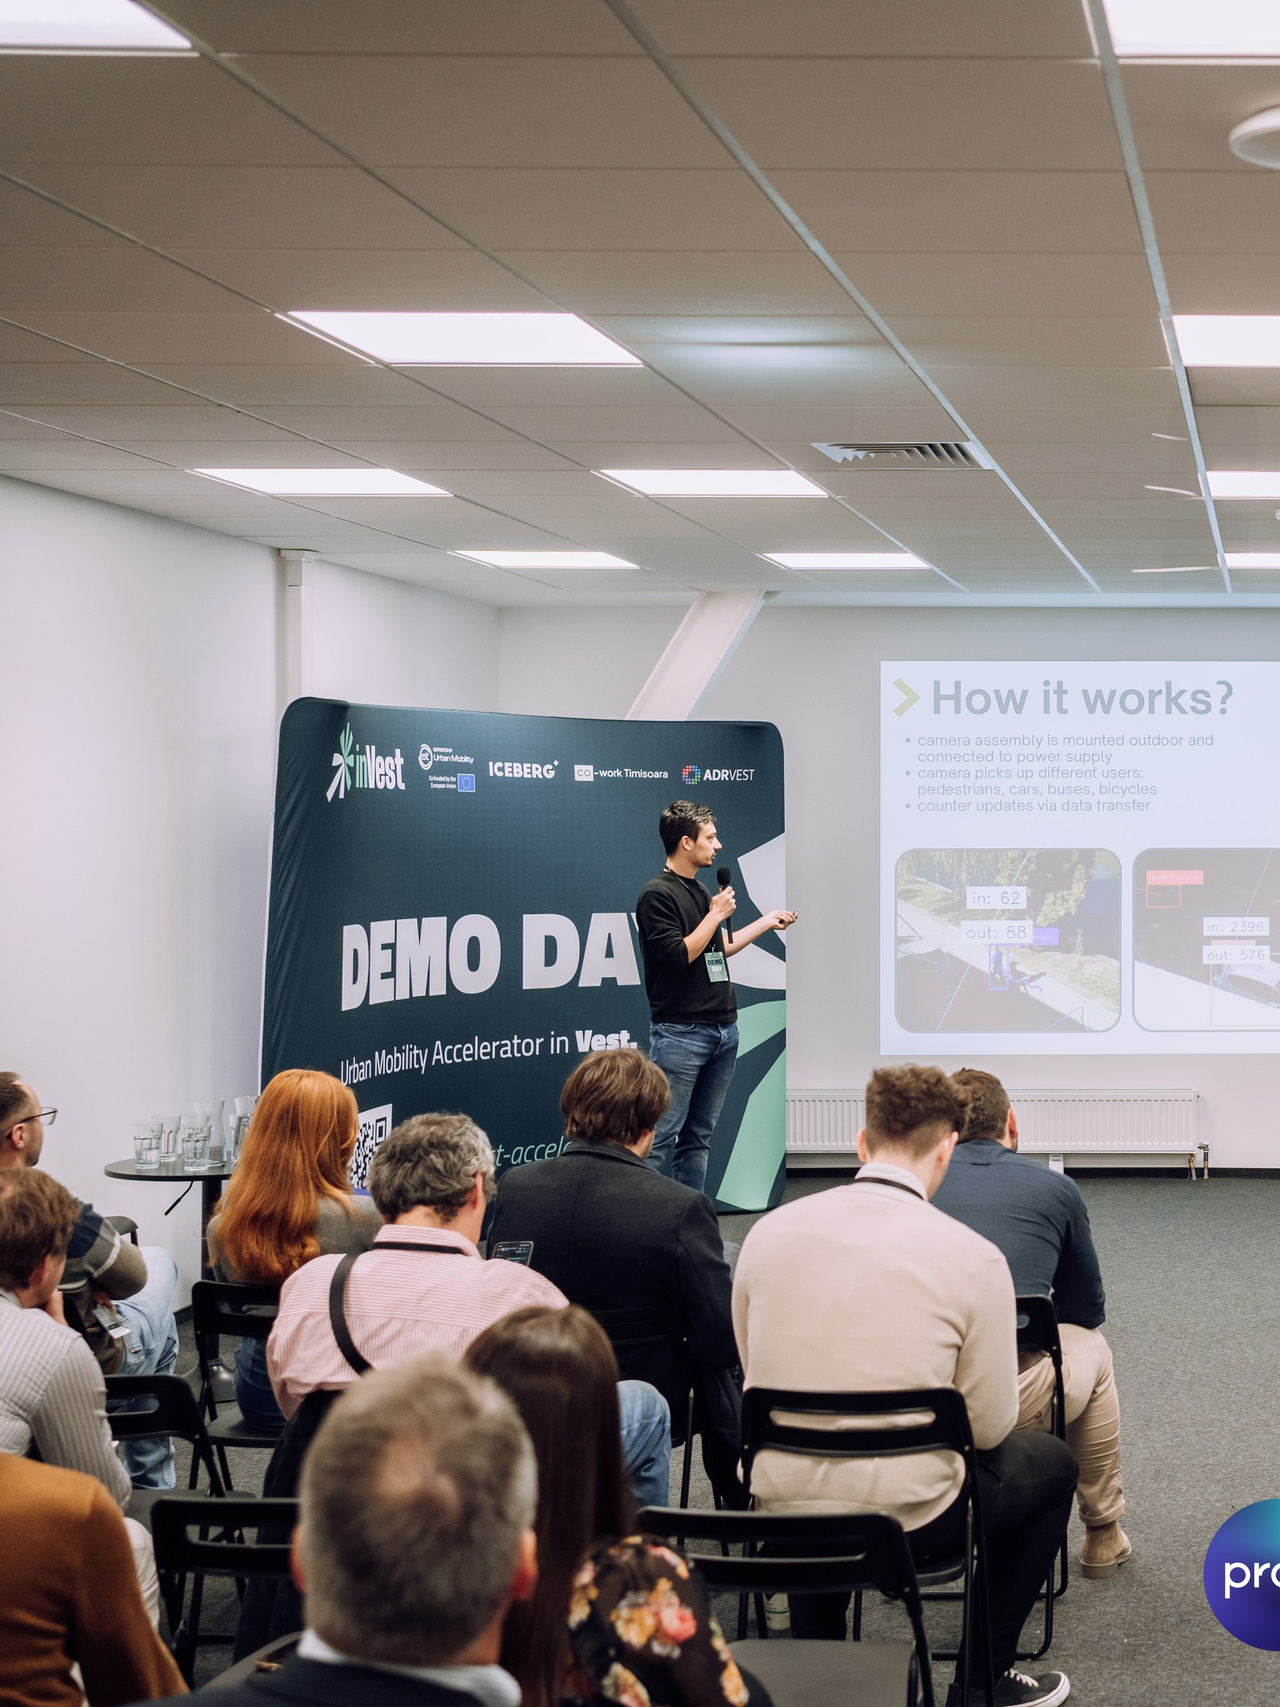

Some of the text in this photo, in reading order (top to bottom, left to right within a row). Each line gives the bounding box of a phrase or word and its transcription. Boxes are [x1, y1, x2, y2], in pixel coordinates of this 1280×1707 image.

[932, 679, 1234, 715] How it works?
[917, 734, 1214, 749] camera assembly is mounted outdoor and
[434, 754, 451, 762] Urban
[451, 755, 474, 764] Mobility
[917, 750, 1113, 766] connected to power supply
[623, 768, 668, 779] Timisoara
[703, 769, 755, 781] ADRVEST
[917, 766, 1144, 782] camera picks up different users:
[917, 782, 1157, 798] pedestrians, cars, buses, bicycles
[917, 799, 1151, 814] counter updates via data transfer
[972, 891, 1020, 905] in: 62
[966, 925, 1026, 939] out: 88
[1208, 921, 1264, 932] in: 2396
[341, 912, 641, 1011] DEMO DA
[1208, 949, 1265, 961] out: 576
[340, 1030, 638, 1087] Urban Mobility Accelerator in Vest.
